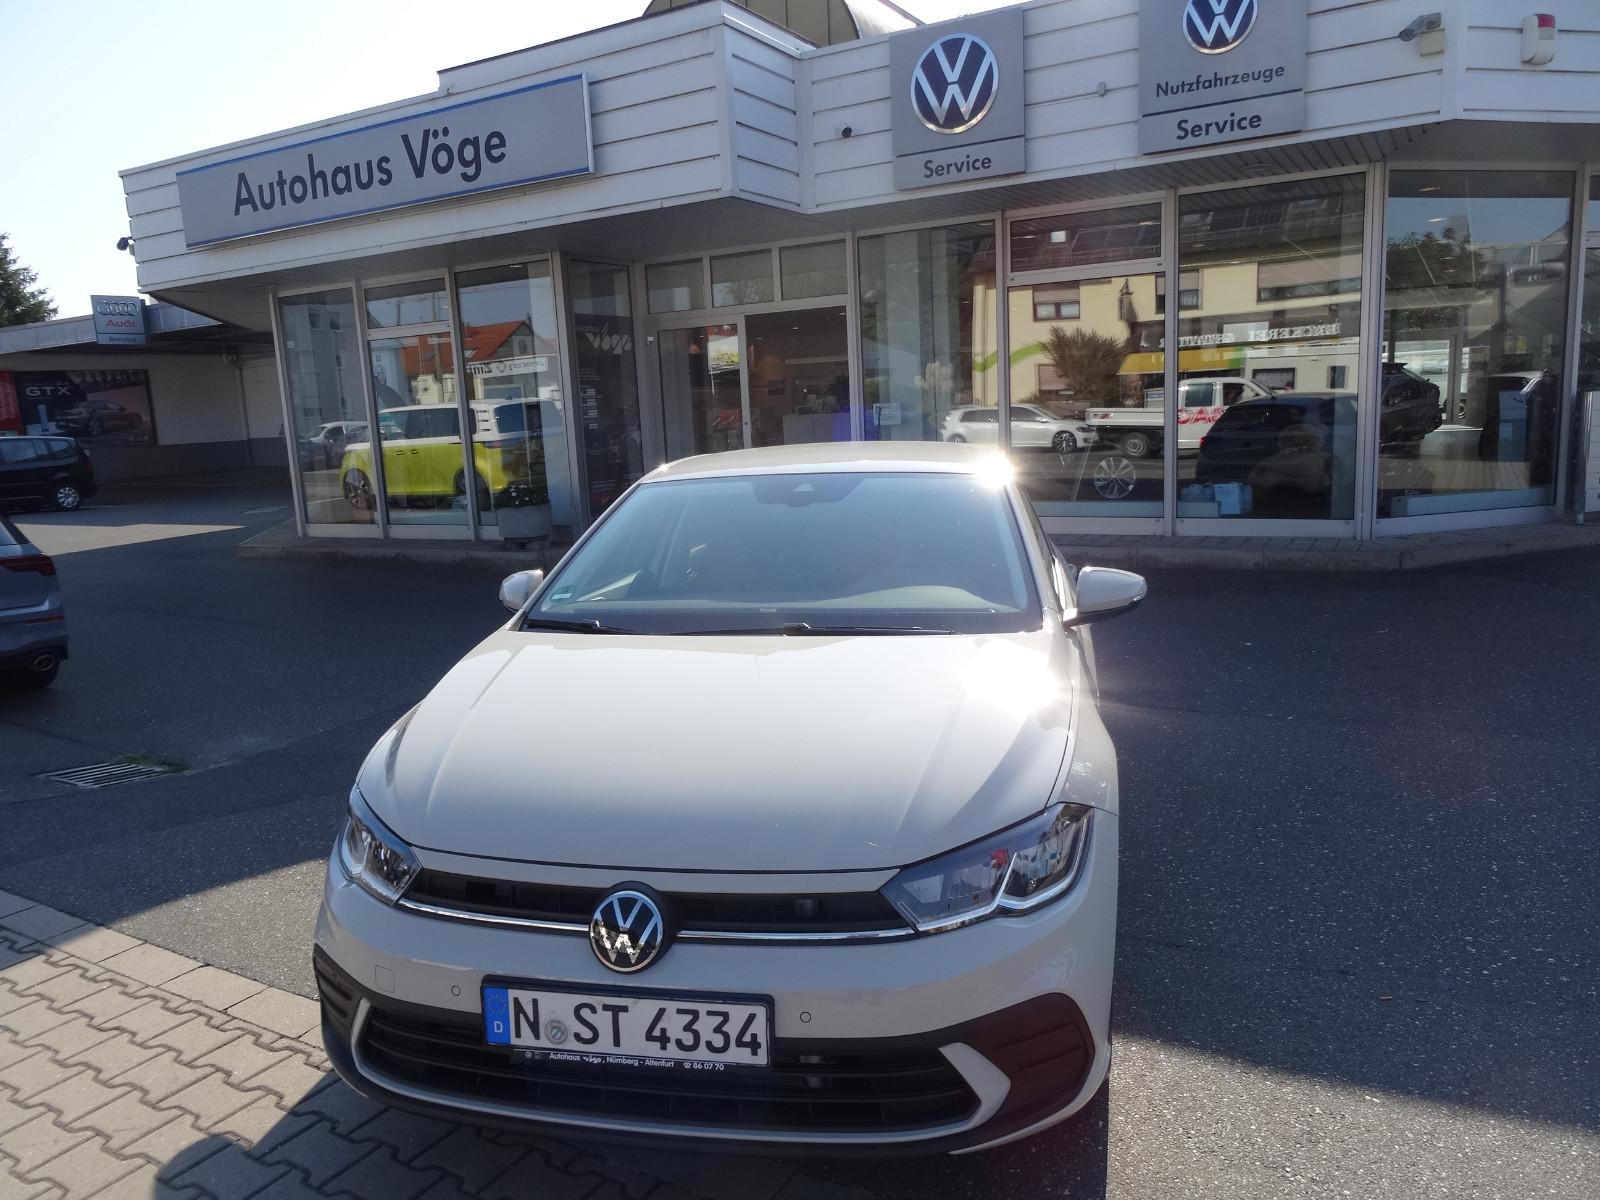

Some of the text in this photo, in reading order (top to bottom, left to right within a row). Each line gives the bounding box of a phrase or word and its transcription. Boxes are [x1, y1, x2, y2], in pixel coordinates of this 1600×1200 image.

[1155, 65, 1286, 98] Nutzfahrzeuge
[1176, 112, 1263, 141] Service
[234, 126, 507, 217] Autohaus Vöge
[923, 154, 992, 179] Service
[105, 319, 137, 328] Audi
[25, 385, 72, 397] GTX
[493, 1021, 504, 1033] D
[512, 997, 762, 1057] N ST 4334
[549, 1052, 581, 1061] Autohaus
[606, 1056, 639, 1066] Nürnberg
[645, 1059, 674, 1068] Altenfurt
